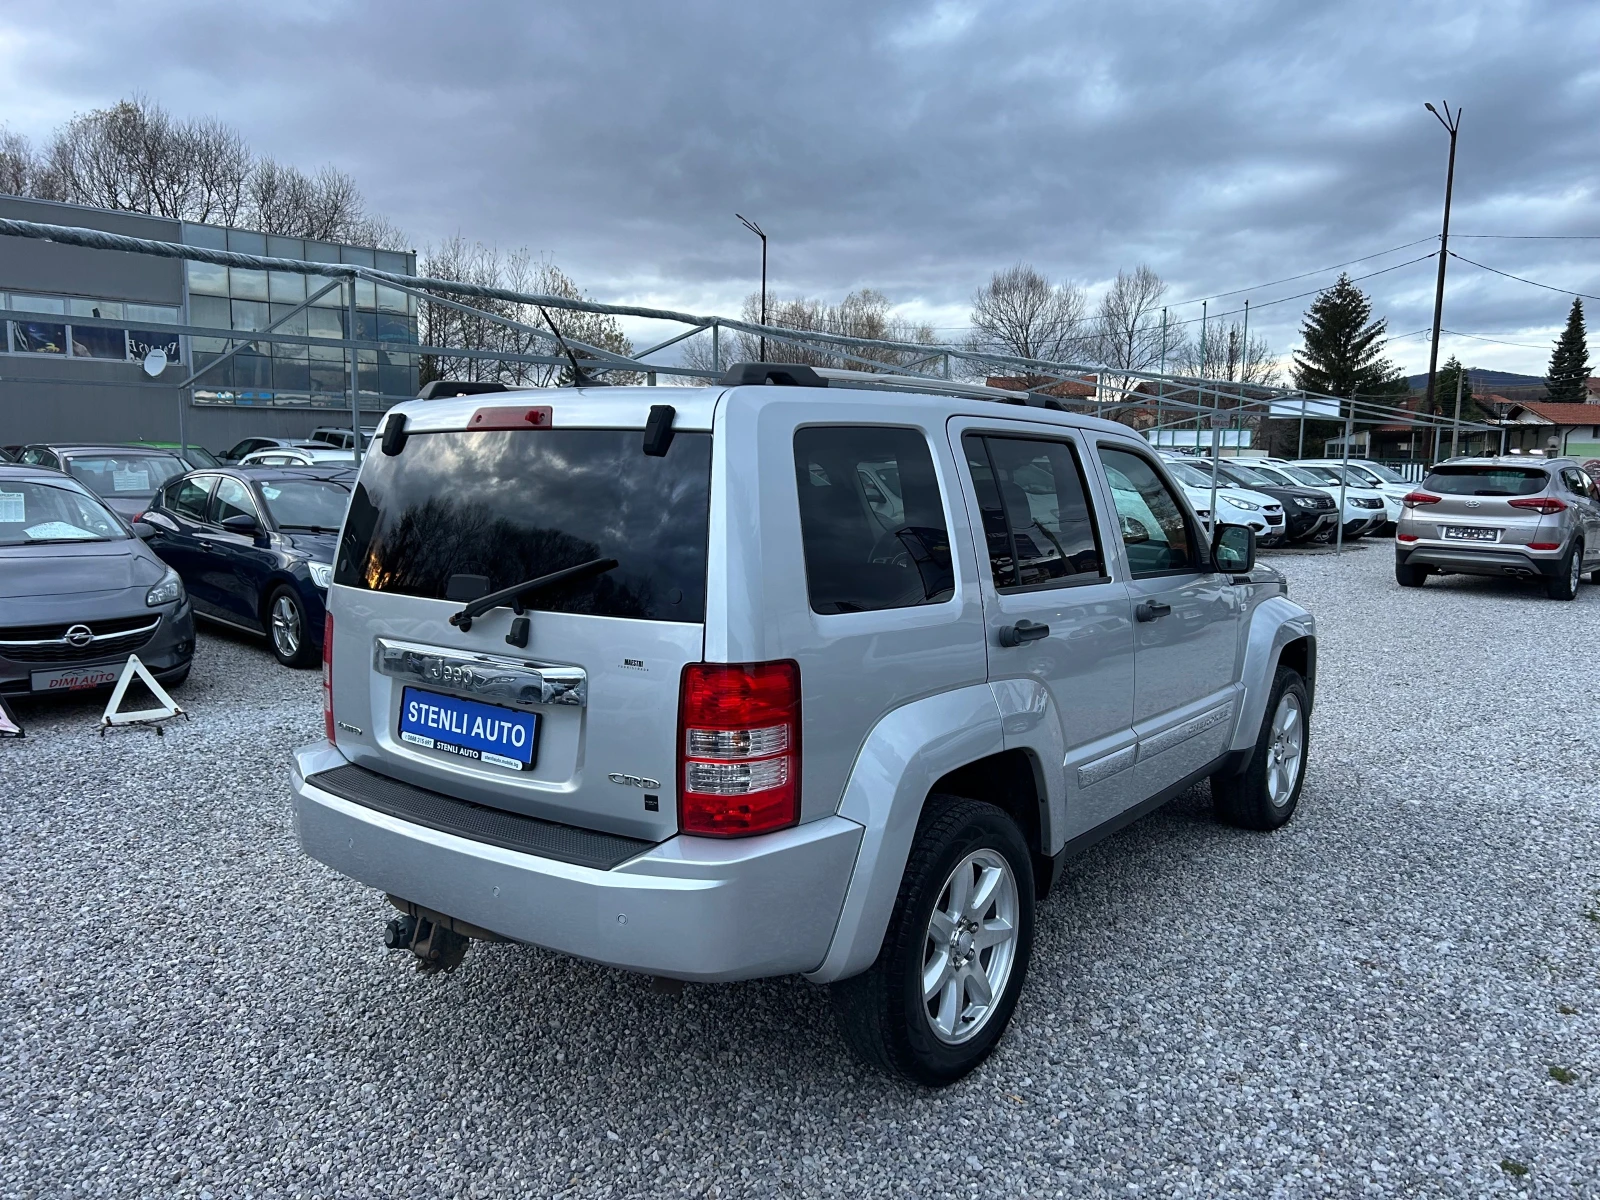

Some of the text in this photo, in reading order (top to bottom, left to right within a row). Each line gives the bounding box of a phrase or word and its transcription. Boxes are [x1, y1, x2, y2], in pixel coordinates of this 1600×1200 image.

[624, 659, 643, 667] MAESTRI
[49, 673, 115, 688] DIMI AUTO
[431, 659, 473, 686] Jeep
[408, 701, 526, 748] STENLI AUTO
[436, 742, 479, 759] STENLI AUTO
[608, 772, 661, 789] CRD
